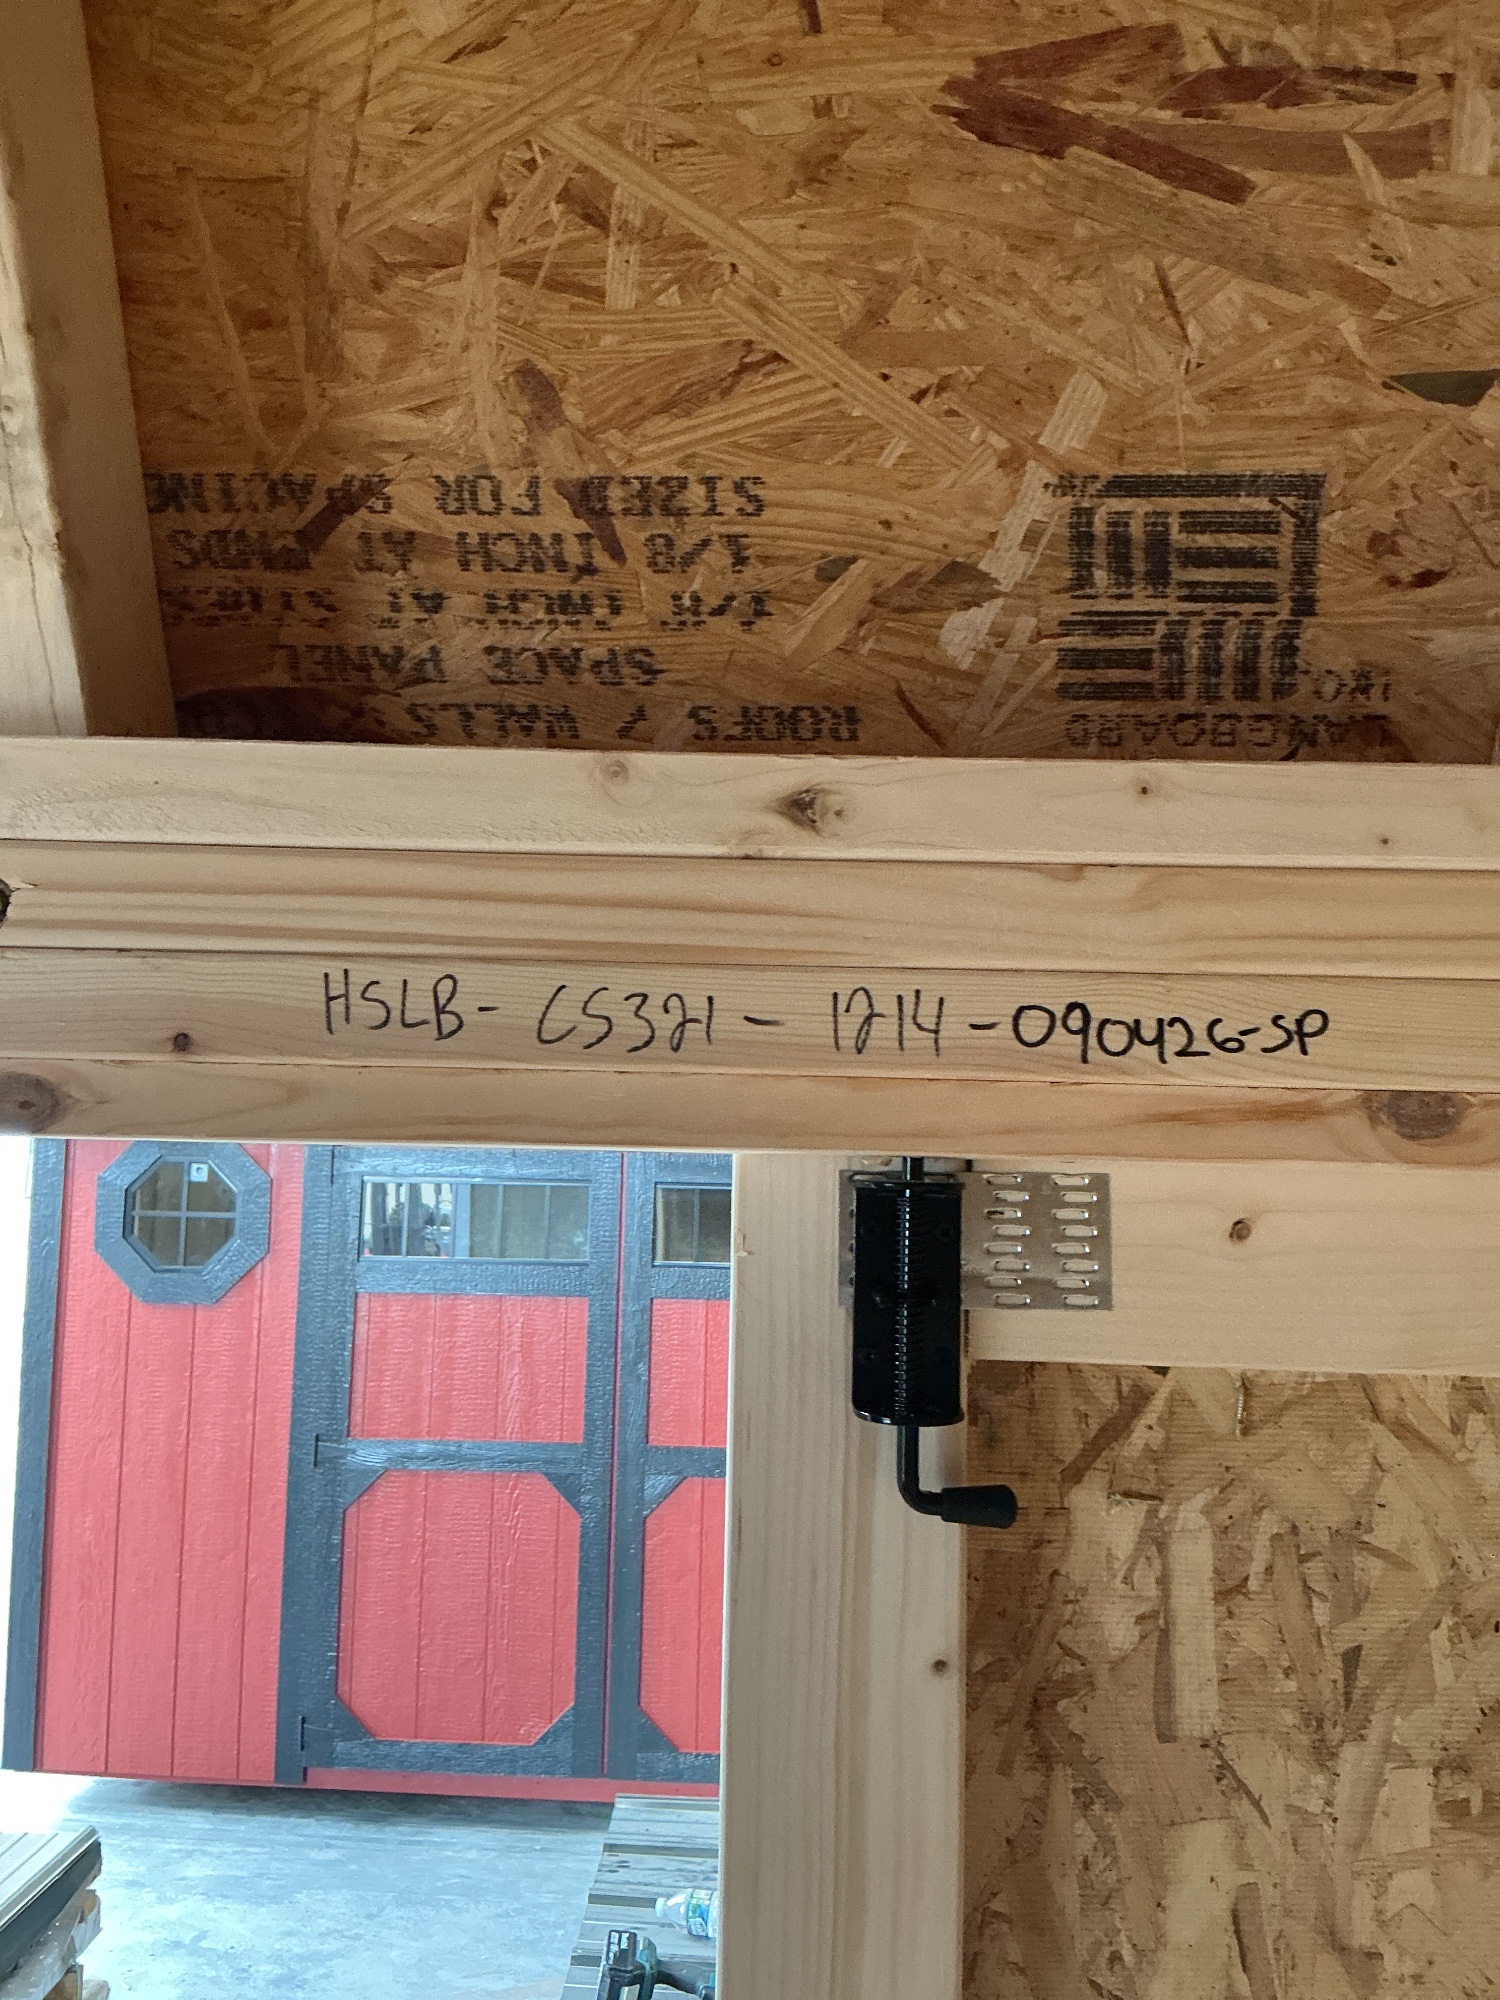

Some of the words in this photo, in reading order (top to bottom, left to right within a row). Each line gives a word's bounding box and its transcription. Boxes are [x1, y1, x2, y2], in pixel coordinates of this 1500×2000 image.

[433, 474, 541, 516] FOR
[578, 475, 766, 517] SIZED
[354, 531, 415, 573] AT
[457, 531, 598, 575] INCH
[644, 533, 751, 574] 1/8
[269, 645, 450, 685] PANEL
[483, 647, 667, 688] SPACE
[404, 703, 582, 740] WALLS
[688, 705, 860, 743] ROOFS
[1065, 713, 1392, 748] LANGBOARD
